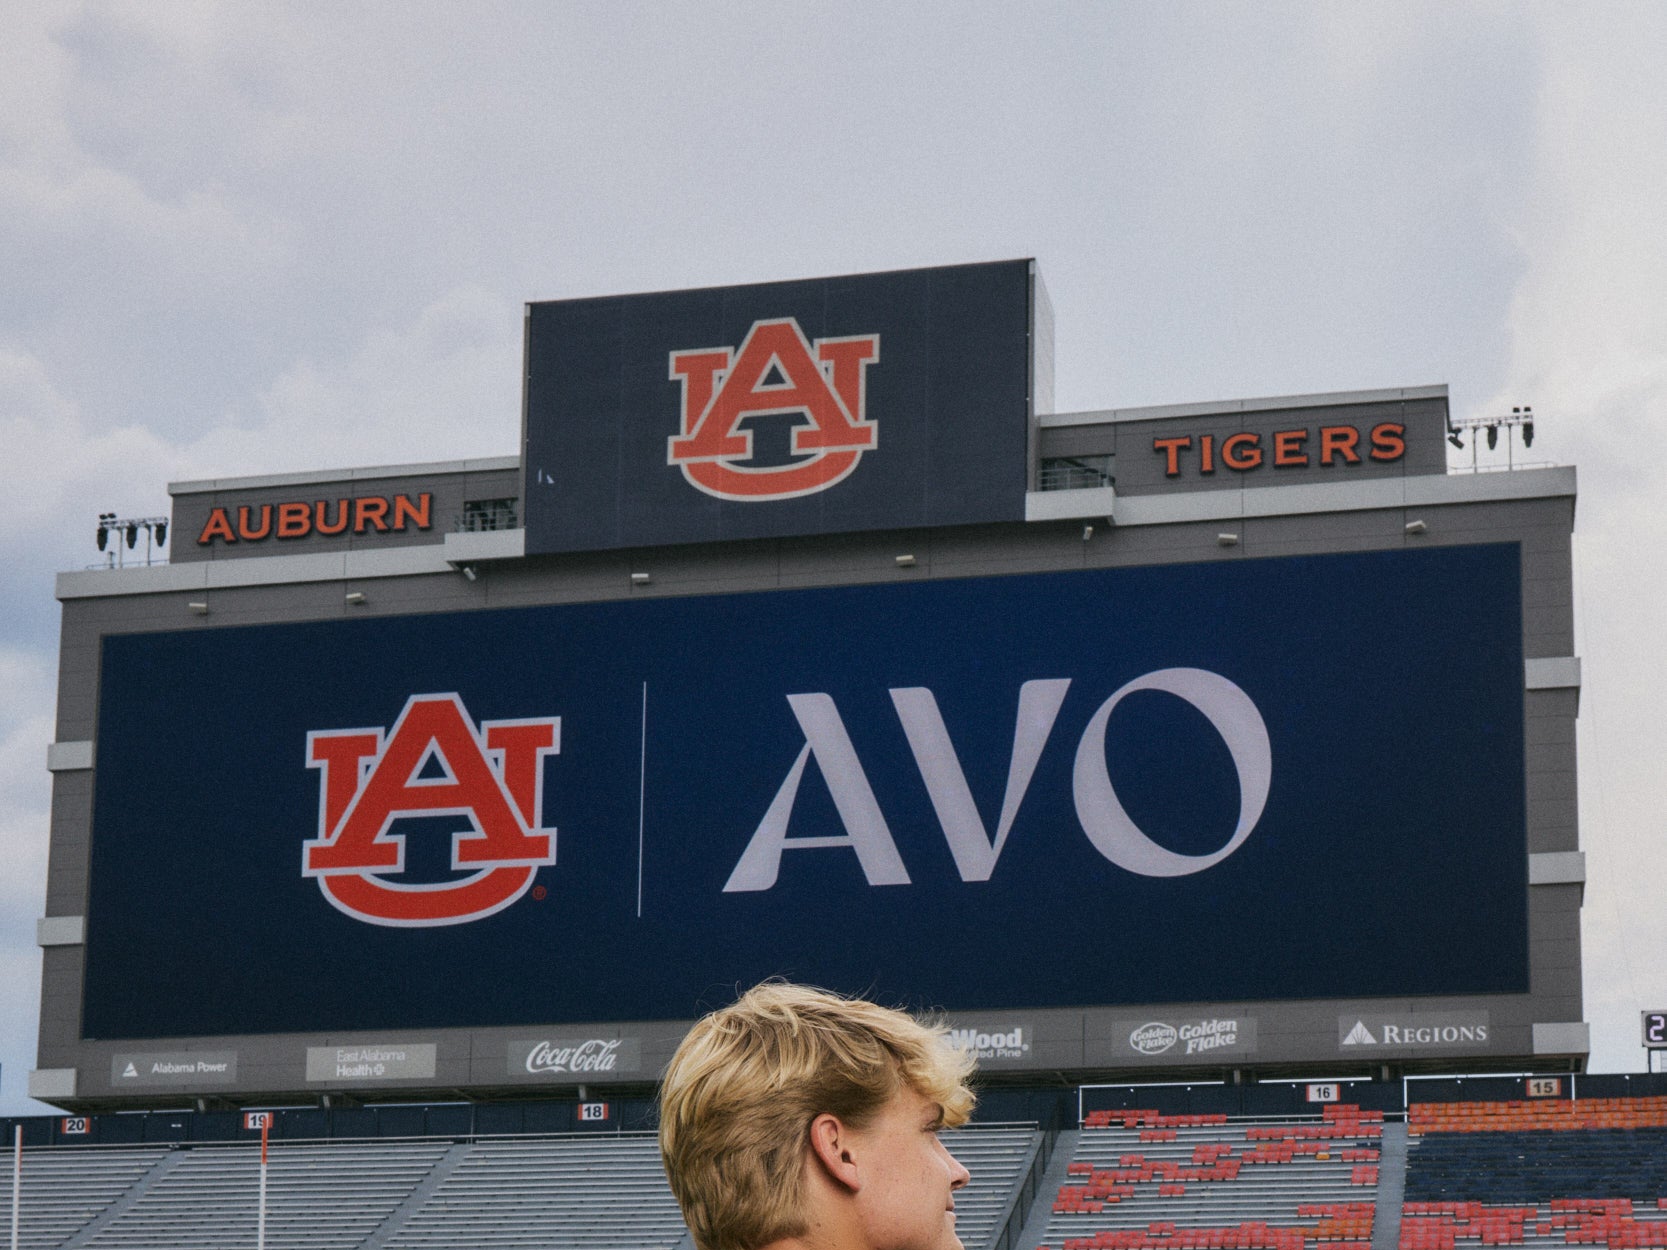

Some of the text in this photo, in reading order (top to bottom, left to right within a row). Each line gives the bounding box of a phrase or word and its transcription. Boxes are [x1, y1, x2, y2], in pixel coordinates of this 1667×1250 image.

[1153, 423, 1405, 476] TIGERS
[199, 492, 431, 543] AUBURN
[720, 666, 1273, 893] AVO
[1132, 1028, 1174, 1042] Golden
[1180, 1019, 1238, 1040] Golden
[1383, 1025, 1488, 1044] REGIONS
[1650, 1016, 1665, 1041] 2
[947, 1028, 1022, 1051] Wood
[1138, 1037, 1173, 1050] Flake
[1185, 1032, 1236, 1055] Flake
[337, 1048, 405, 1062] East Alabama
[526, 1039, 622, 1073] Coca-Cola
[997, 1048, 1022, 1058] Pine
[151, 1061, 228, 1074] Alabama Power
[336, 1063, 373, 1077] Health
[1315, 1087, 1331, 1099] 16
[1533, 1081, 1553, 1094] 15
[584, 1106, 602, 1118] 18
[67, 1120, 85, 1131] 20
[250, 1114, 266, 1127] 19
